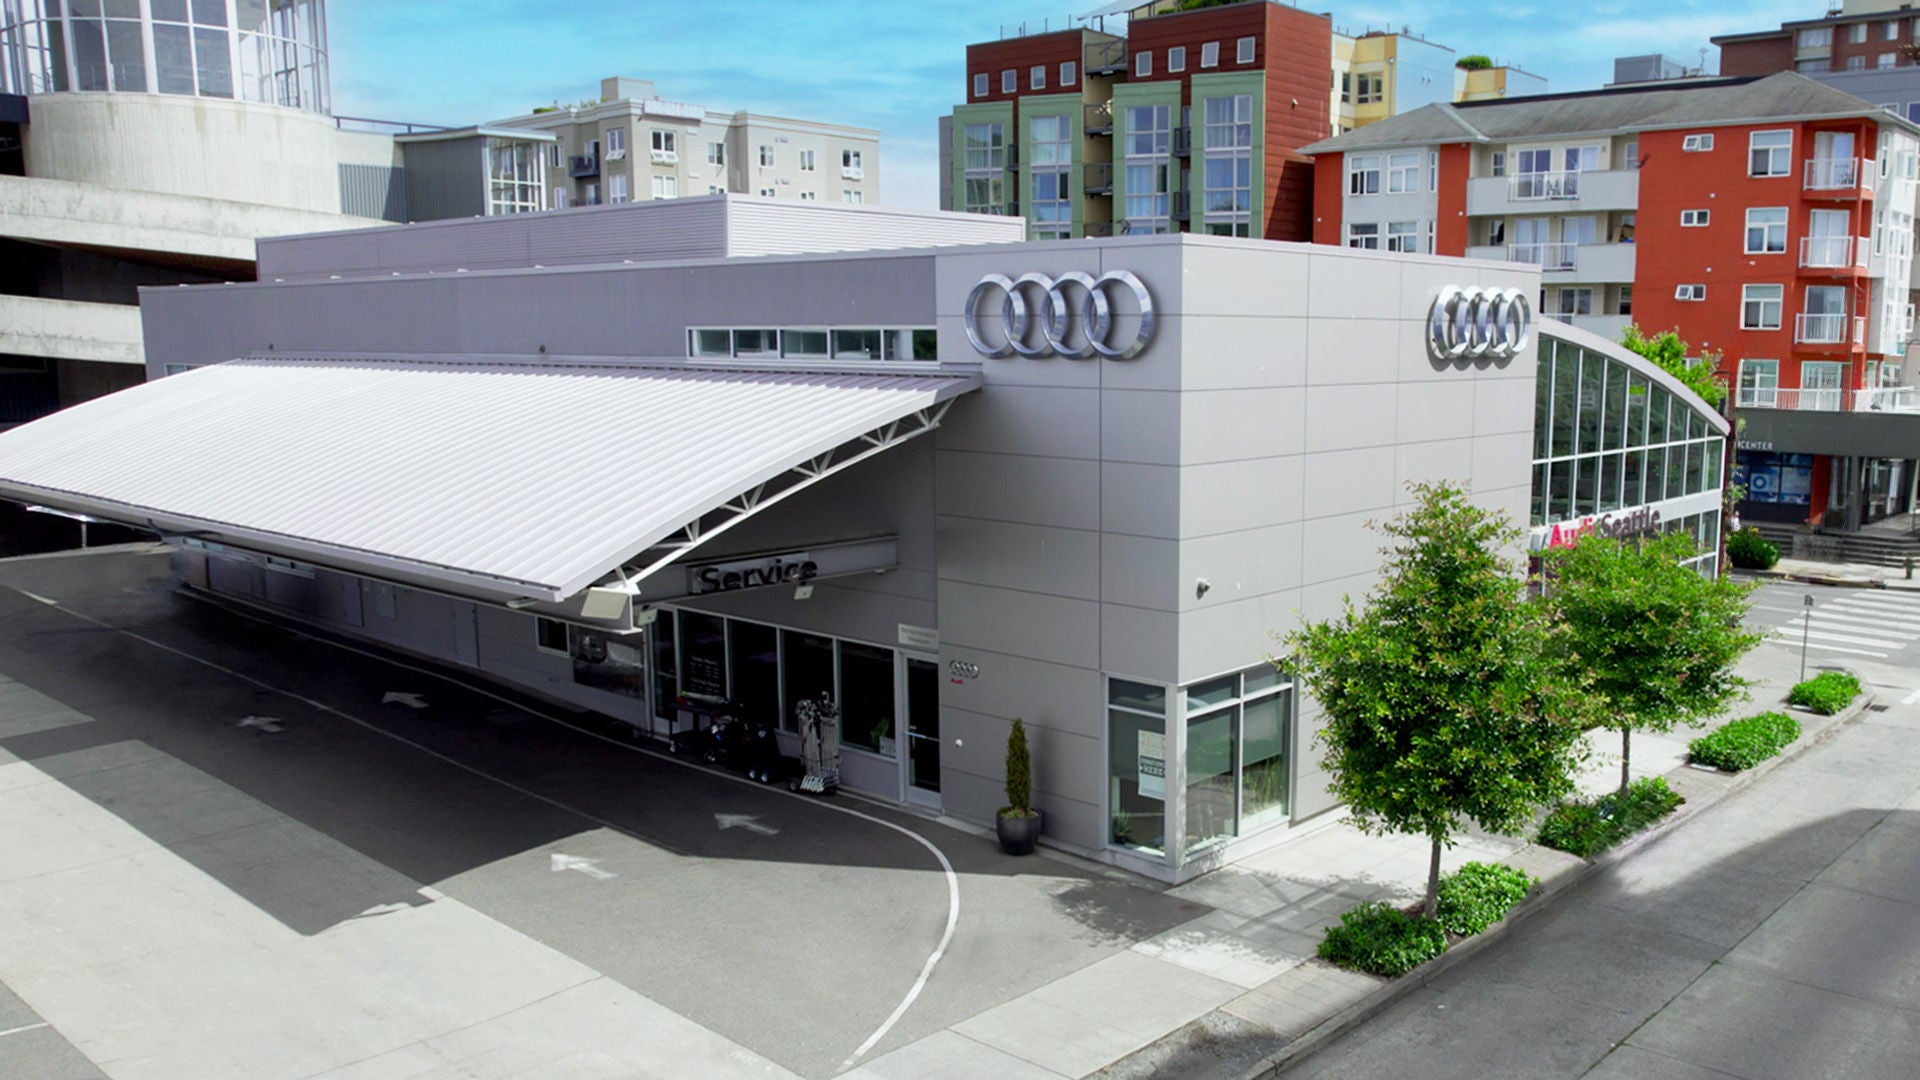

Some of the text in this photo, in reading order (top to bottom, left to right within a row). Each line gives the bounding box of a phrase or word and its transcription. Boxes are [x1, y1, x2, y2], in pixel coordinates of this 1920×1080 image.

[1737, 440, 1773, 450] CENTER
[1601, 505, 1660, 538] Seattle
[701, 559, 818, 593] Service
